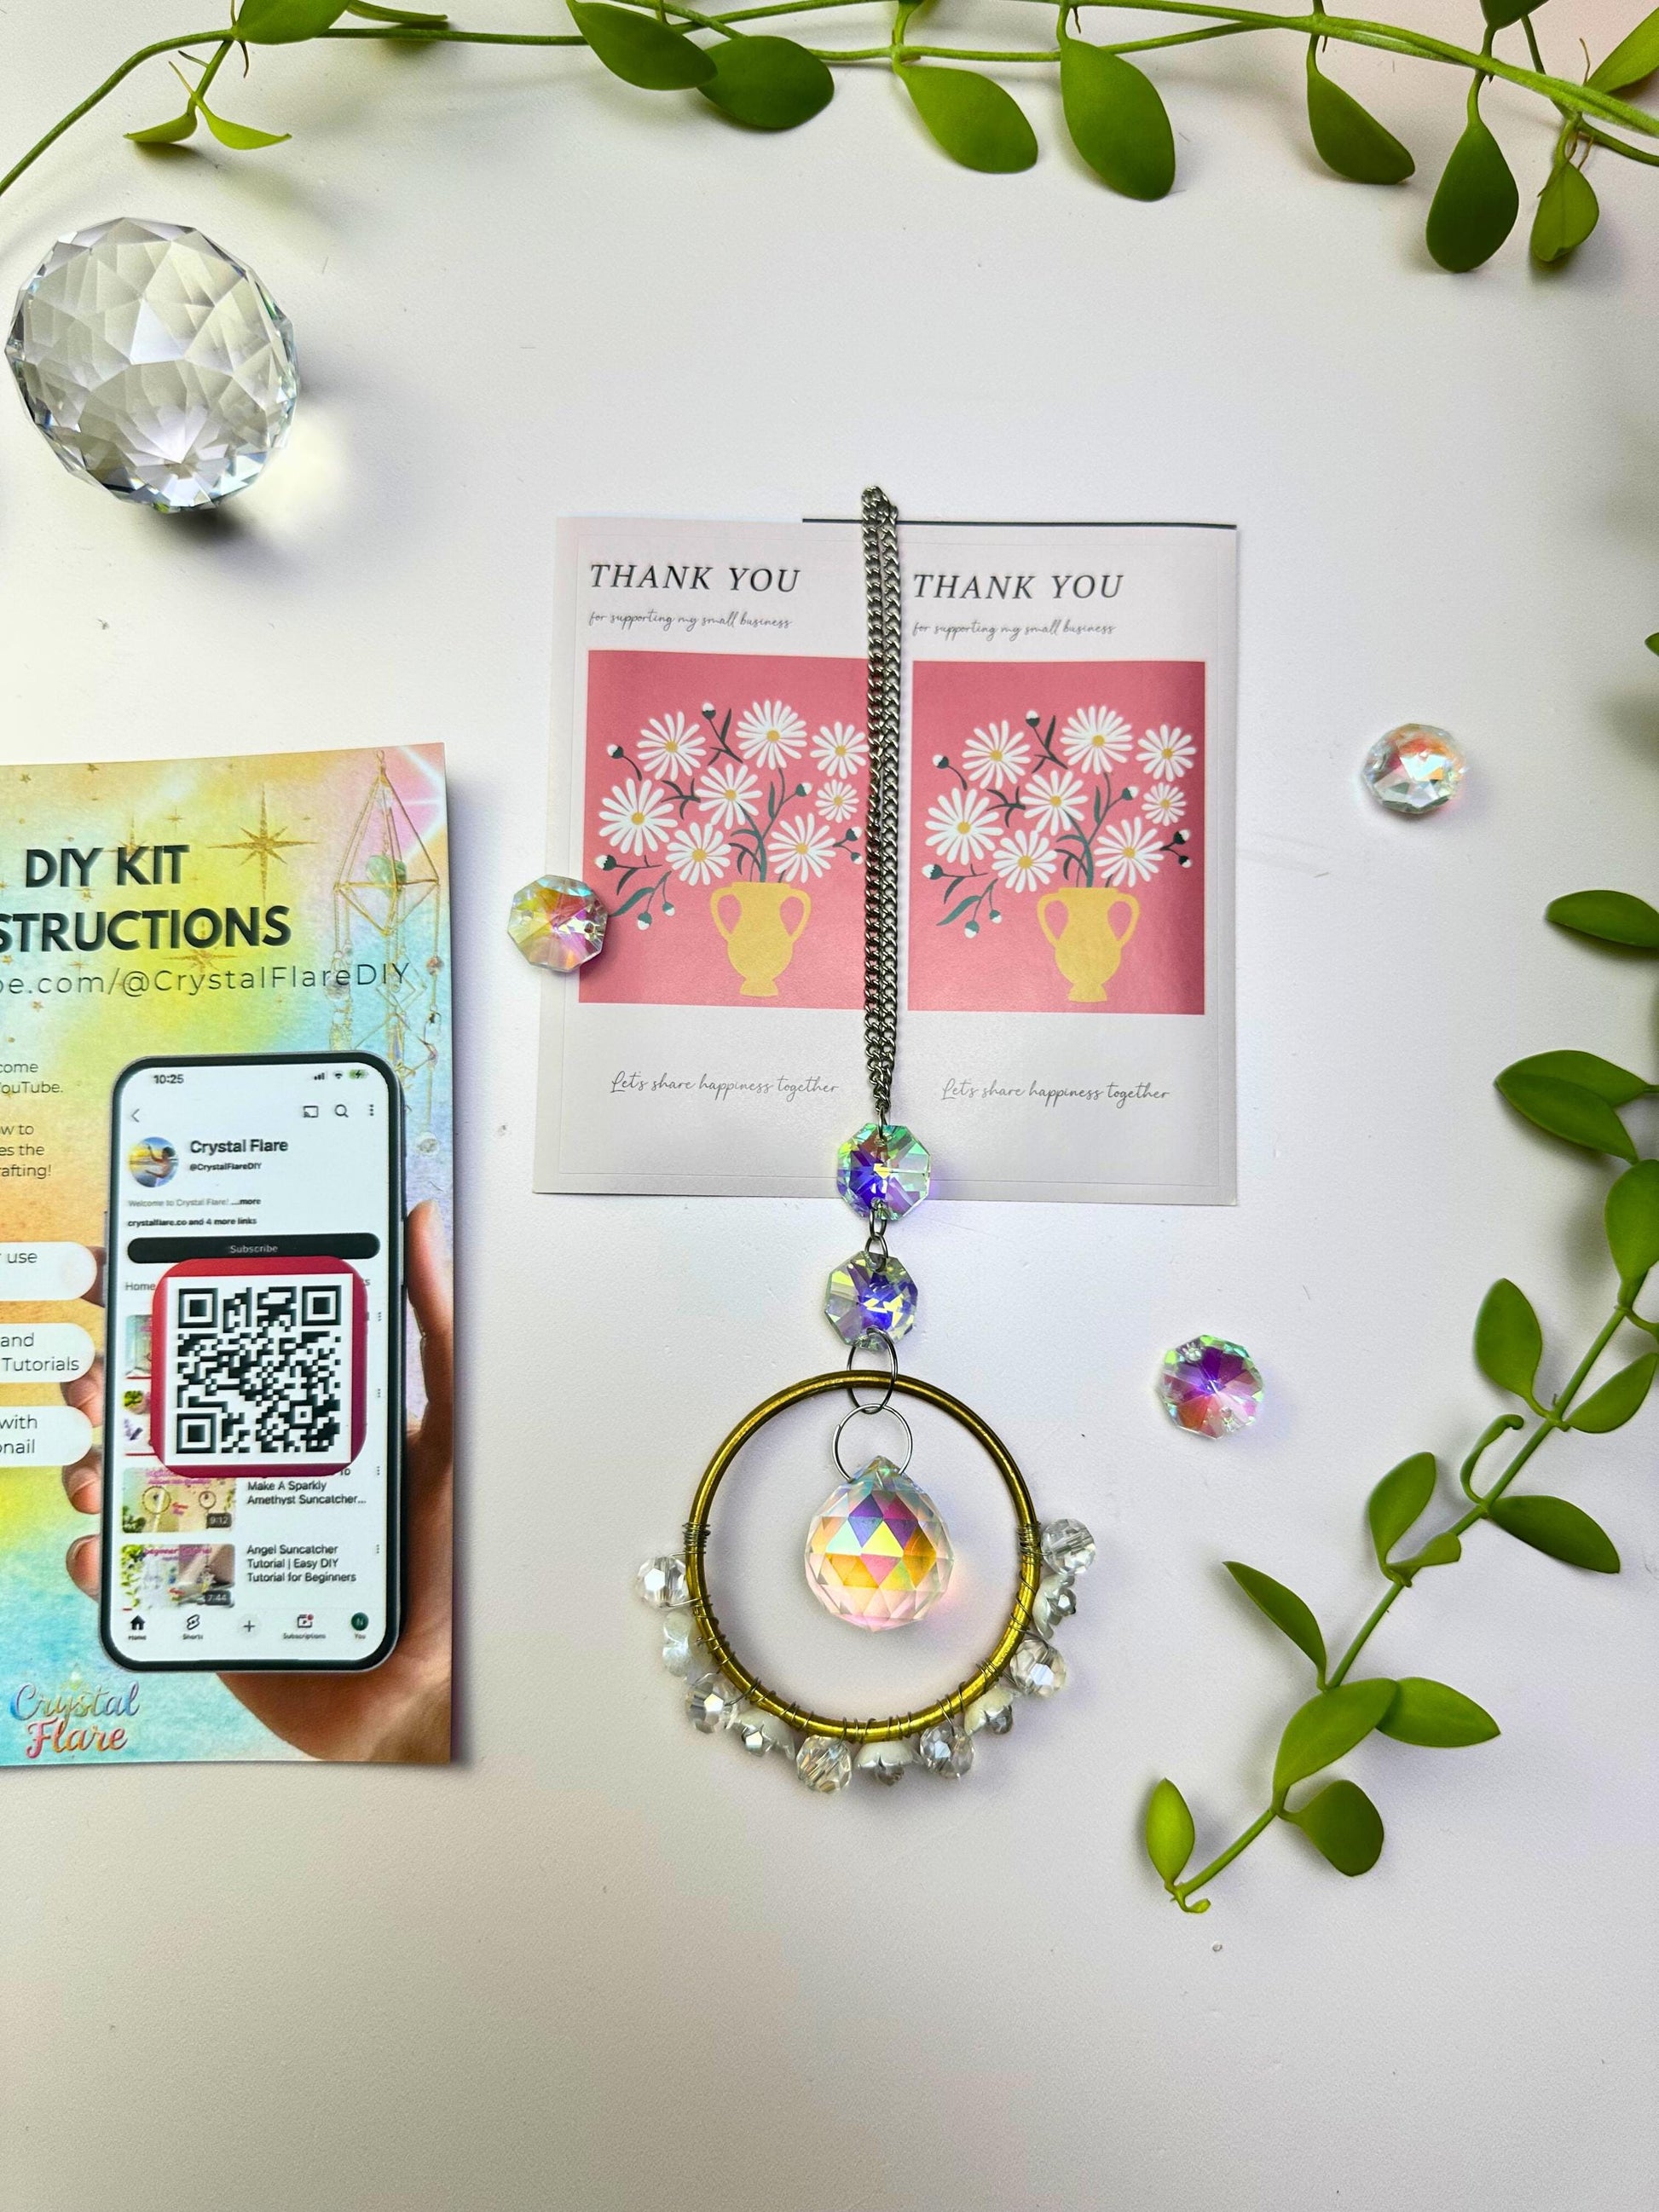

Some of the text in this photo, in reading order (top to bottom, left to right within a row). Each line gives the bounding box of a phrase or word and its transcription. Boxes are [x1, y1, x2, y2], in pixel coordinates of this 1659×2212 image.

[591, 564, 801, 592] THANK YOU
[913, 574, 1124, 599] THANK YOU
[588, 609, 793, 632] for supporting my small business
[912, 619, 1117, 642] for supporting my small business
[26, 845, 190, 887] DIY KIT
[0, 962, 409, 997] e.com/@CrystalFlareDIY
[153, 1074, 185, 1084] 10:25
[610, 1071, 839, 1102] Let's share happiness together
[0, 1081, 63, 1094] ouTube.
[941, 1077, 1170, 1109] Let's share happiness together
[18, 1124, 34, 1135] to
[19, 1143, 45, 1156] the
[190, 1139, 288, 1156] Crystal Flare
[0, 1164, 51, 1179] afting!
[189, 1162, 263, 1172] @CrystalFlareDIY
[128, 1198, 165, 1207] Welcome
[176, 1198, 203, 1208] Crystal
[206, 1198, 229, 1206] Flare!
[127, 1219, 187, 1227] crystalflare.co
[229, 1245, 279, 1254] Subscribe
[7, 1252, 38, 1263] use
[125, 1281, 156, 1291] Home
[0, 1331, 35, 1347] and
[1, 1356, 80, 1372] Tutorials
[0, 1414, 38, 1429] with
[0, 1439, 36, 1454] nail
[247, 1480, 327, 1492] Make A Sparkly
[247, 1495, 296, 1505] Amethyst
[246, 1544, 338, 1556] Angel Suncatcher
[247, 1558, 285, 1568] Tutorial
[293, 1558, 318, 1570] Easy
[321, 1558, 339, 1568] DIY
[247, 1572, 356, 1583] Tutorial for Beginners
[10, 1681, 140, 1725] Crystal
[26, 1717, 128, 1759] Flare
